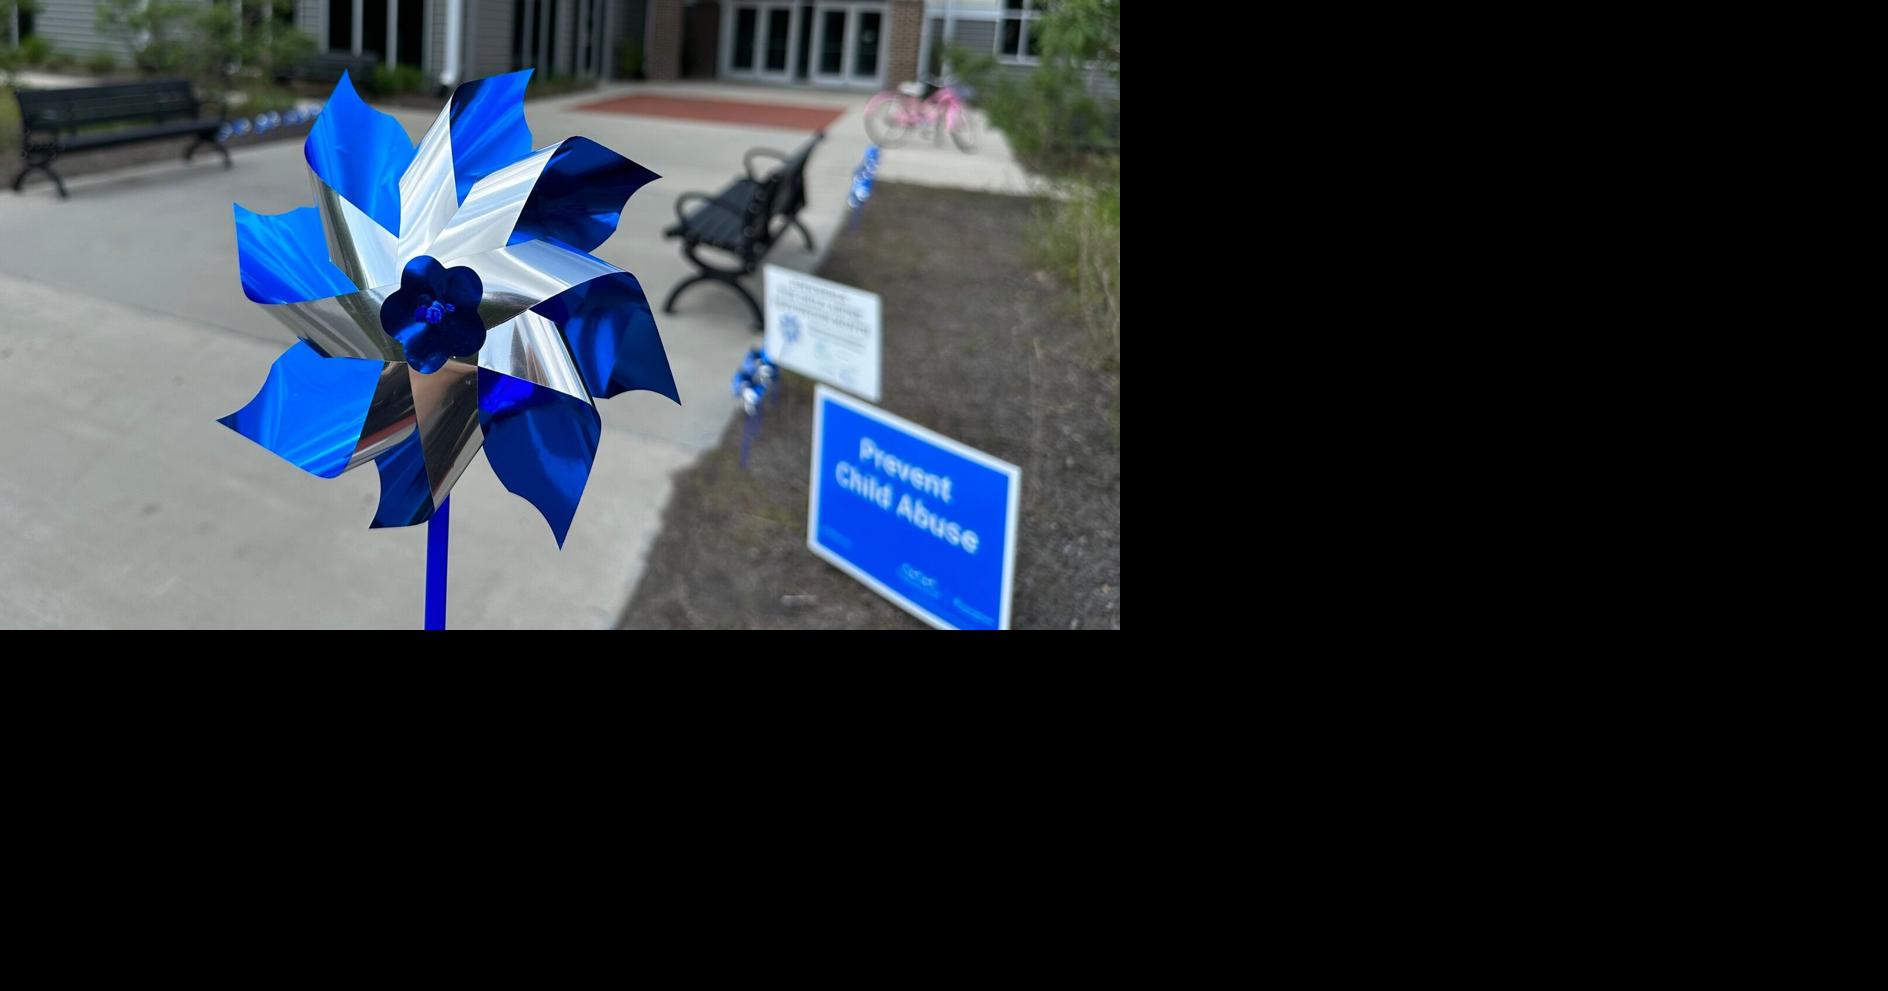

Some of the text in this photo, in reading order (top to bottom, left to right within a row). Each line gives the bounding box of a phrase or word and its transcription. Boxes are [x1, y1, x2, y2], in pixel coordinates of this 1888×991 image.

[836, 461, 892, 510] Child
[897, 494, 979, 553] Abuse
[859, 437, 952, 503] Prevent
